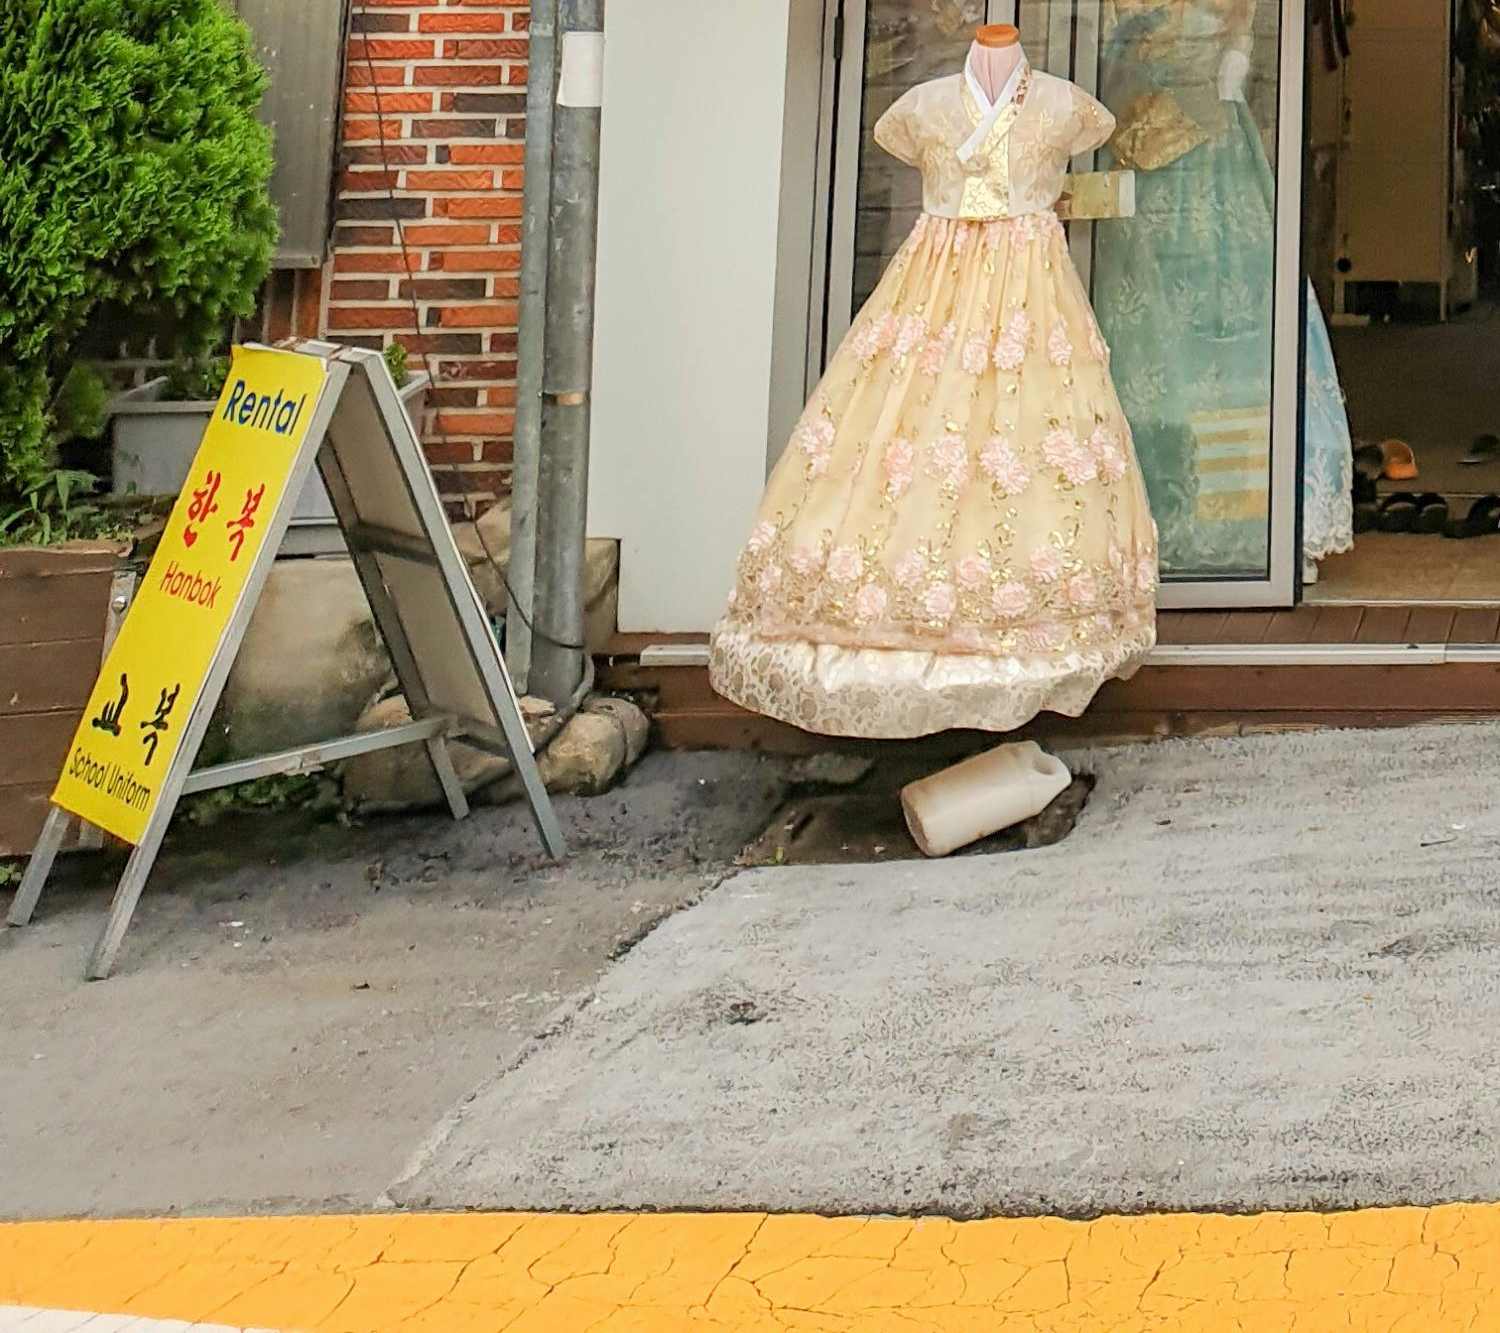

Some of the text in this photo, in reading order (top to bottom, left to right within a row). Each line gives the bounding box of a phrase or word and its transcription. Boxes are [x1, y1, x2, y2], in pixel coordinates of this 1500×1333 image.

[223, 378, 307, 437] Rental
[183, 469, 266, 562] 한복
[159, 560, 222, 609] Hanbok
[91, 672, 181, 767] 교복
[69, 746, 151, 812] School Uniform
